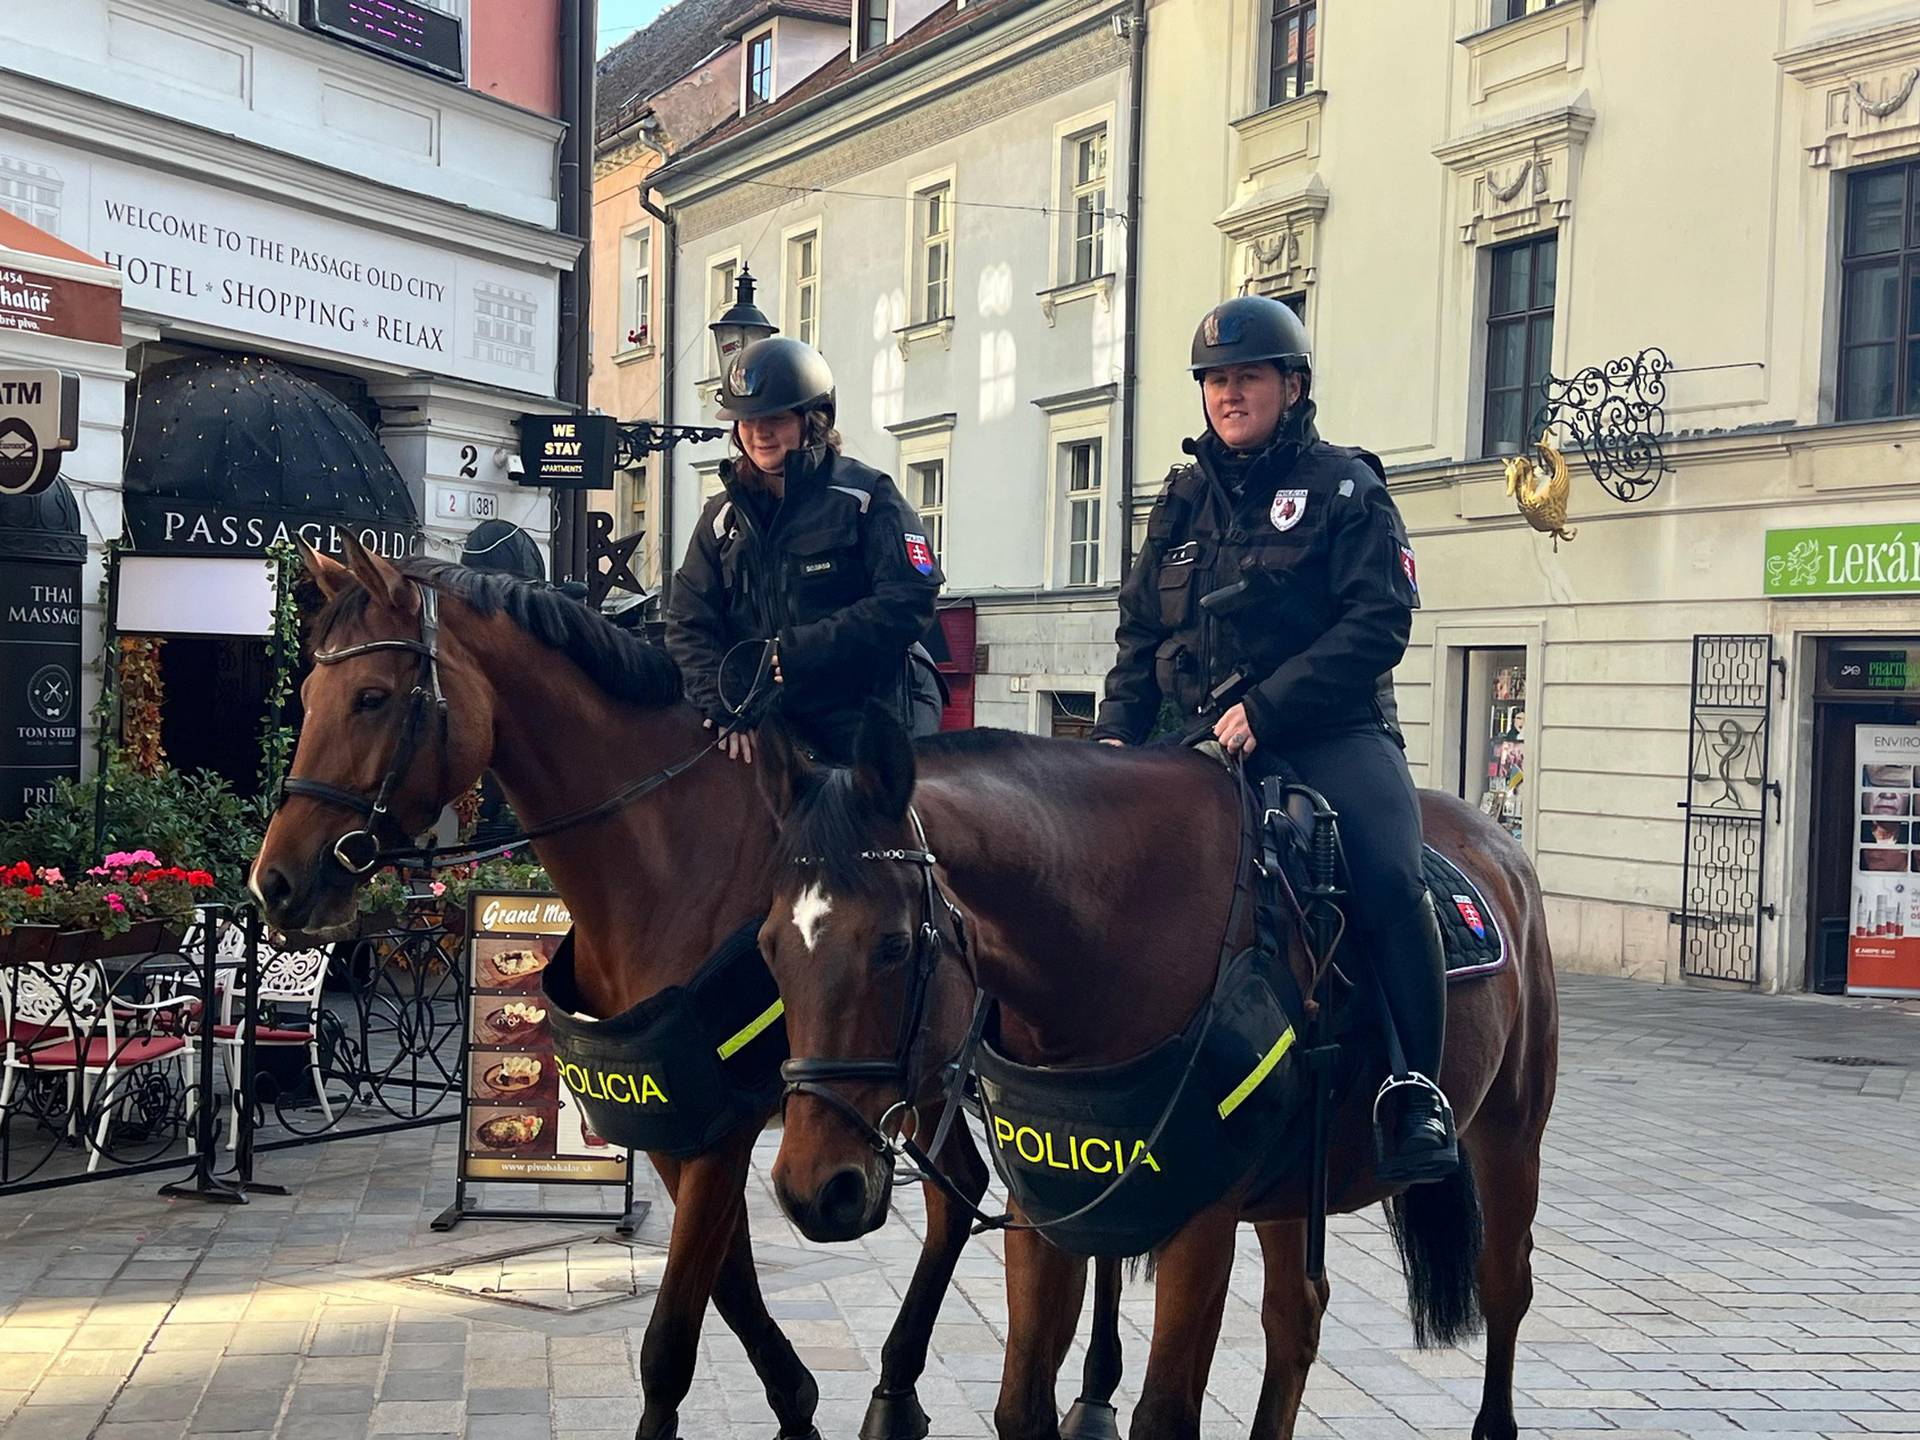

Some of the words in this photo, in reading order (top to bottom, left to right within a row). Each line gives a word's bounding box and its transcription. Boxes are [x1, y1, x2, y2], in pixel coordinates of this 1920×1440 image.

[105, 200, 207, 244] WELCOME
[214, 227, 241, 252] TO
[247, 236, 284, 263] THE
[291, 247, 361, 282] PASSAGE
[367, 267, 402, 292] OLD
[407, 277, 444, 302] CITY
[104, 251, 197, 297] HOTEL
[221, 279, 355, 332] SHOPPING
[377, 315, 443, 351] RELAX
[553, 424, 575, 437] WE
[544, 443, 581, 455] STAY
[460, 445, 477, 478] 2
[541, 464, 582, 473] APARTMENTS
[450, 495, 456, 512] 2
[476, 497, 494, 516] 381
[164, 512, 343, 554] PASSAGE
[359, 528, 404, 560] OLD
[31, 586, 72, 603] THAI
[17, 727, 47, 738] TOM
[482, 901, 540, 930] Grand
[994, 1116, 1161, 1174] POLICIA
